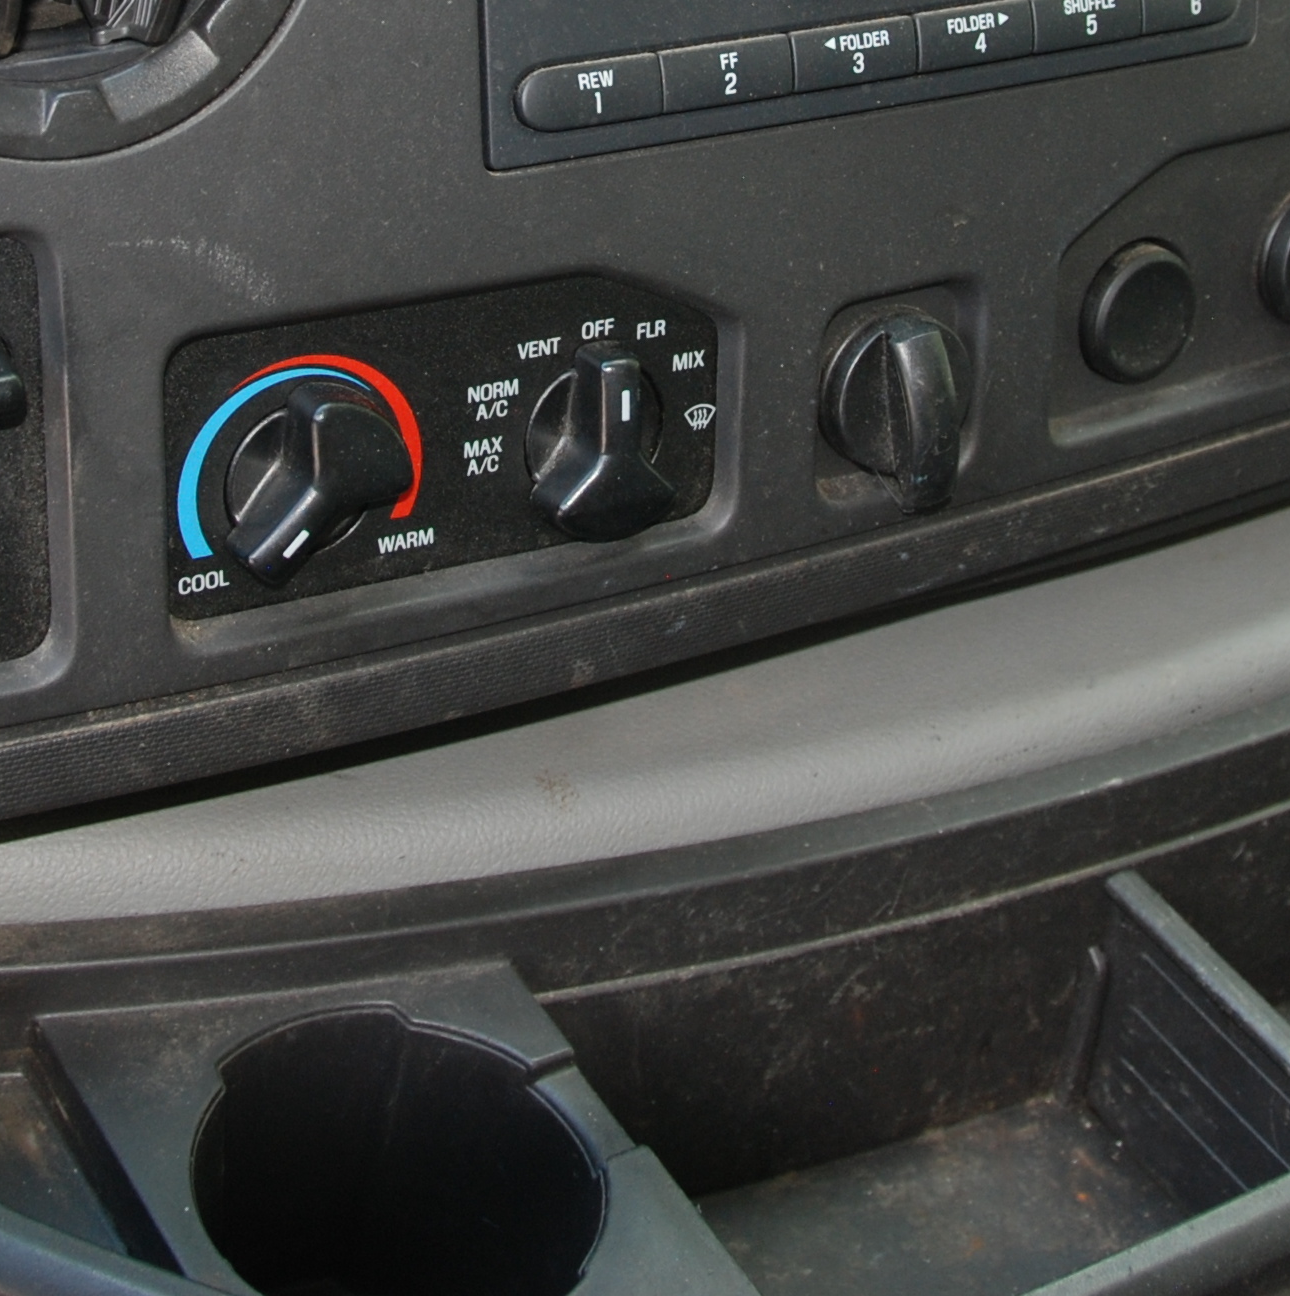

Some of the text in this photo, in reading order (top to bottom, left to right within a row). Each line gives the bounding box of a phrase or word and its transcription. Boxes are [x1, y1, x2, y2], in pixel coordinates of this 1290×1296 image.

[946, 12, 995, 35] FOLDER
[1086, 14, 1098, 36] 5
[839, 29, 890, 52] FOLDER
[974, 32, 987, 53] 4
[719, 51, 739, 70] FF
[852, 52, 865, 74] 3
[577, 69, 614, 90] REW
[724, 72, 738, 95] 2
[593, 91, 603, 114] 1
[581, 317, 615, 340] OFF
[636, 319, 666, 340] FLR
[517, 337, 562, 360] VENT
[672, 349, 705, 372] MIX
[467, 378, 520, 404] NORM
[475, 400, 509, 422] A/C
[463, 435, 503, 460] MAX
[466, 455, 499, 477] A/C
[377, 527, 434, 554] WARM
[178, 569, 230, 595] COOL
